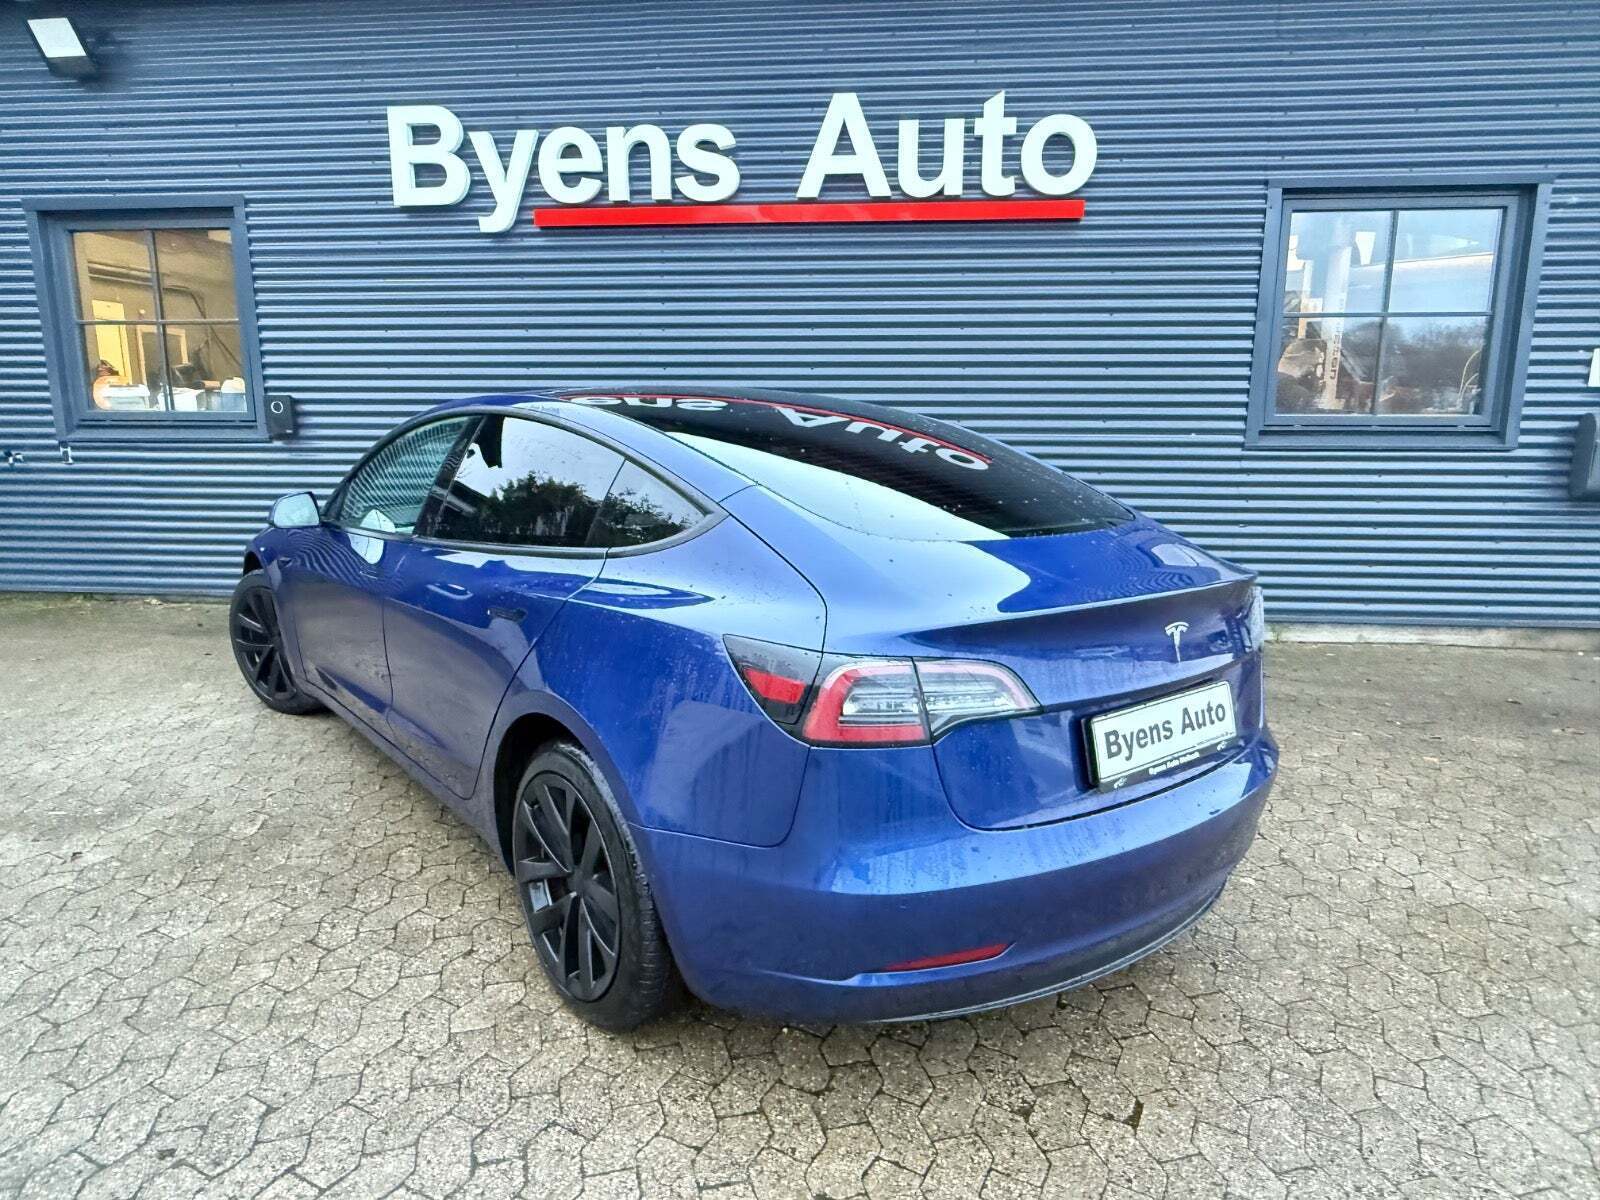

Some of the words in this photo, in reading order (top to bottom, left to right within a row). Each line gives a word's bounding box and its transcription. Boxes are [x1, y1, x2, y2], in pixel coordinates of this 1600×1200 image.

[386, 104, 741, 234] Byens
[796, 90, 1098, 201] Auto
[1104, 719, 1173, 762] Byens
[1181, 700, 1226, 735] Auto
